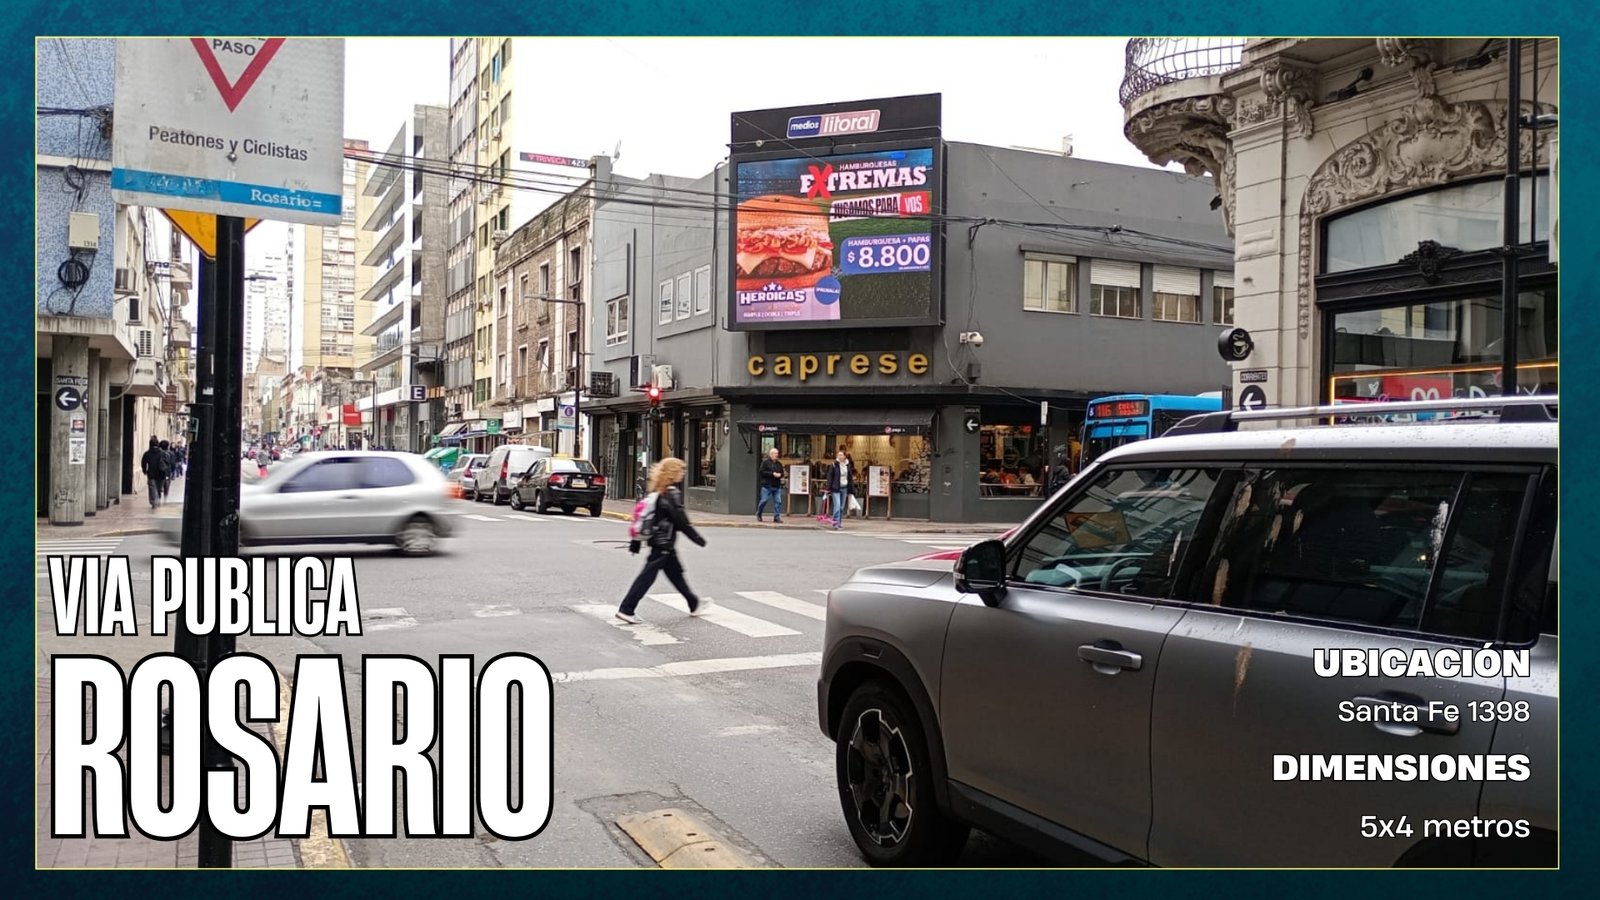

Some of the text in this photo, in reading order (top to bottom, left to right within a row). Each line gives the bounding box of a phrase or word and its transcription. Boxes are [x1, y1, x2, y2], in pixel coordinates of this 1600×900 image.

[212, 38, 256, 56] PASO
[790, 112, 875, 133] medios litoral
[149, 125, 308, 162] Peatones y Ciclistas
[839, 160, 897, 171] HAMBURGUESAS
[799, 164, 927, 200] EXTREMAS
[251, 189, 312, 208] Rosario
[876, 196, 899, 214] PARA
[904, 195, 923, 213] VOS
[848, 237, 901, 247] HAMBURGUESA
[907, 235, 931, 243] PAPAS
[847, 243, 930, 268] $ 8.800
[740, 290, 806, 305] HEROICAS
[747, 353, 929, 381] caprese
[413, 387, 423, 399] E
